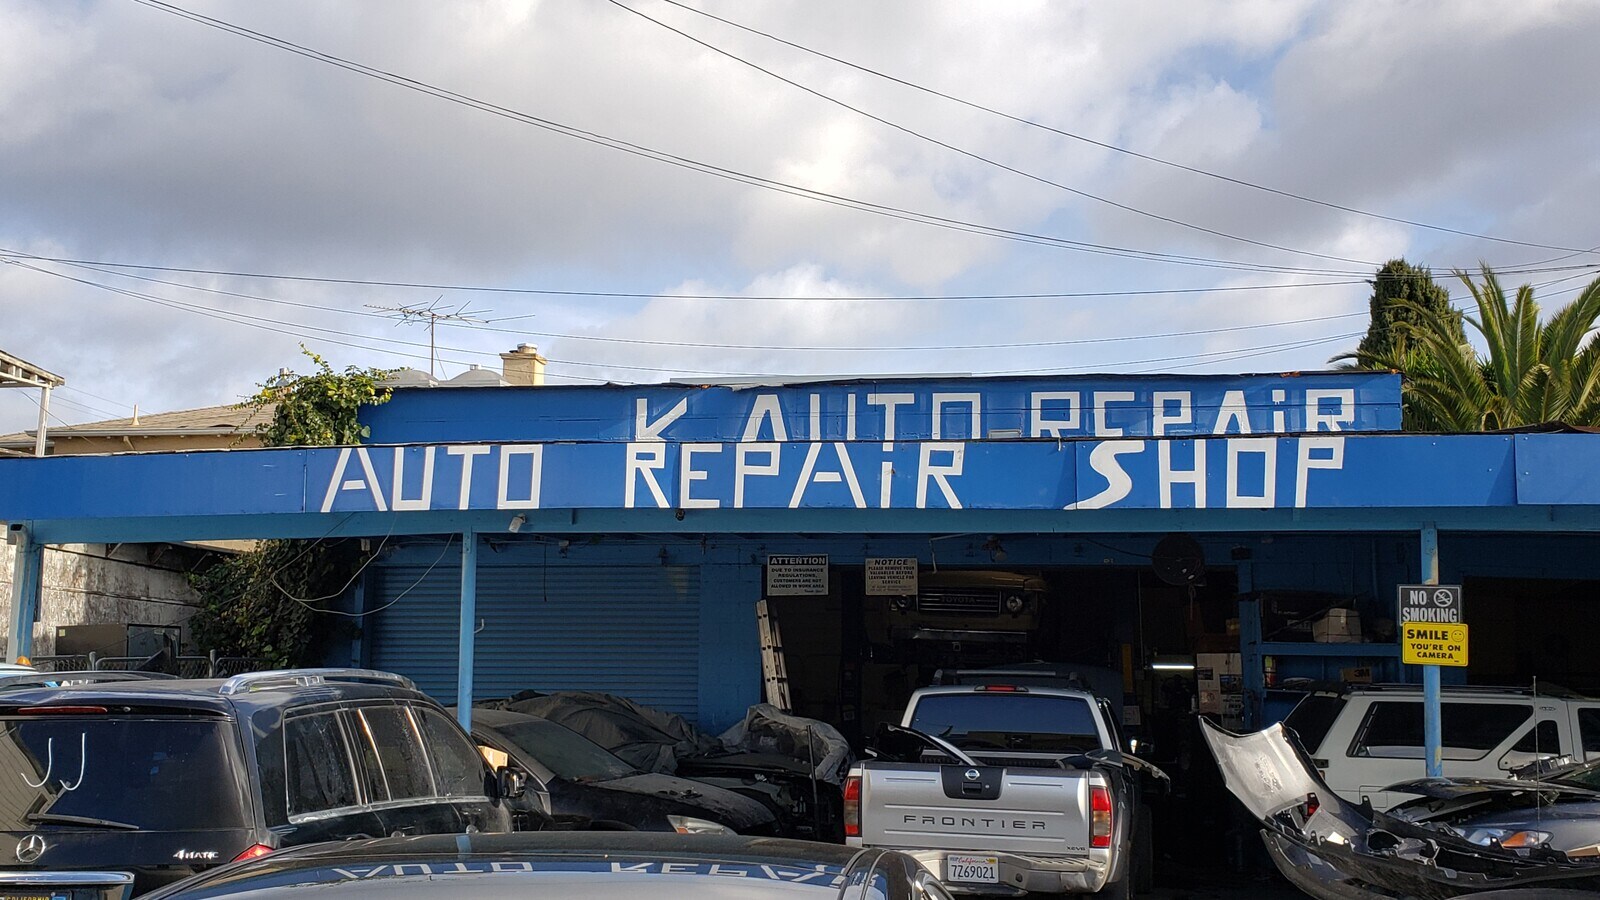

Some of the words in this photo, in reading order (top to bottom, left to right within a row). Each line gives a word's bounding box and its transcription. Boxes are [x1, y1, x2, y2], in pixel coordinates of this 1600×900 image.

[636, 398, 688, 440] K
[321, 444, 542, 511] AUTO
[1063, 436, 1345, 510] SHOP
[770, 557, 825, 565] ATTENTION
[1409, 590, 1427, 605] NO
[1402, 606, 1458, 623] SMOKING
[1406, 629, 1449, 640] SMILE
[1410, 643, 1443, 651] YOU'RE
[1416, 651, 1454, 659] CAMERA
[1354, 669, 1369, 677] 3M
[903, 815, 1046, 830] FRONTIER
[172, 848, 219, 860] 4MATIC
[951, 864, 995, 879] 7Z69021
